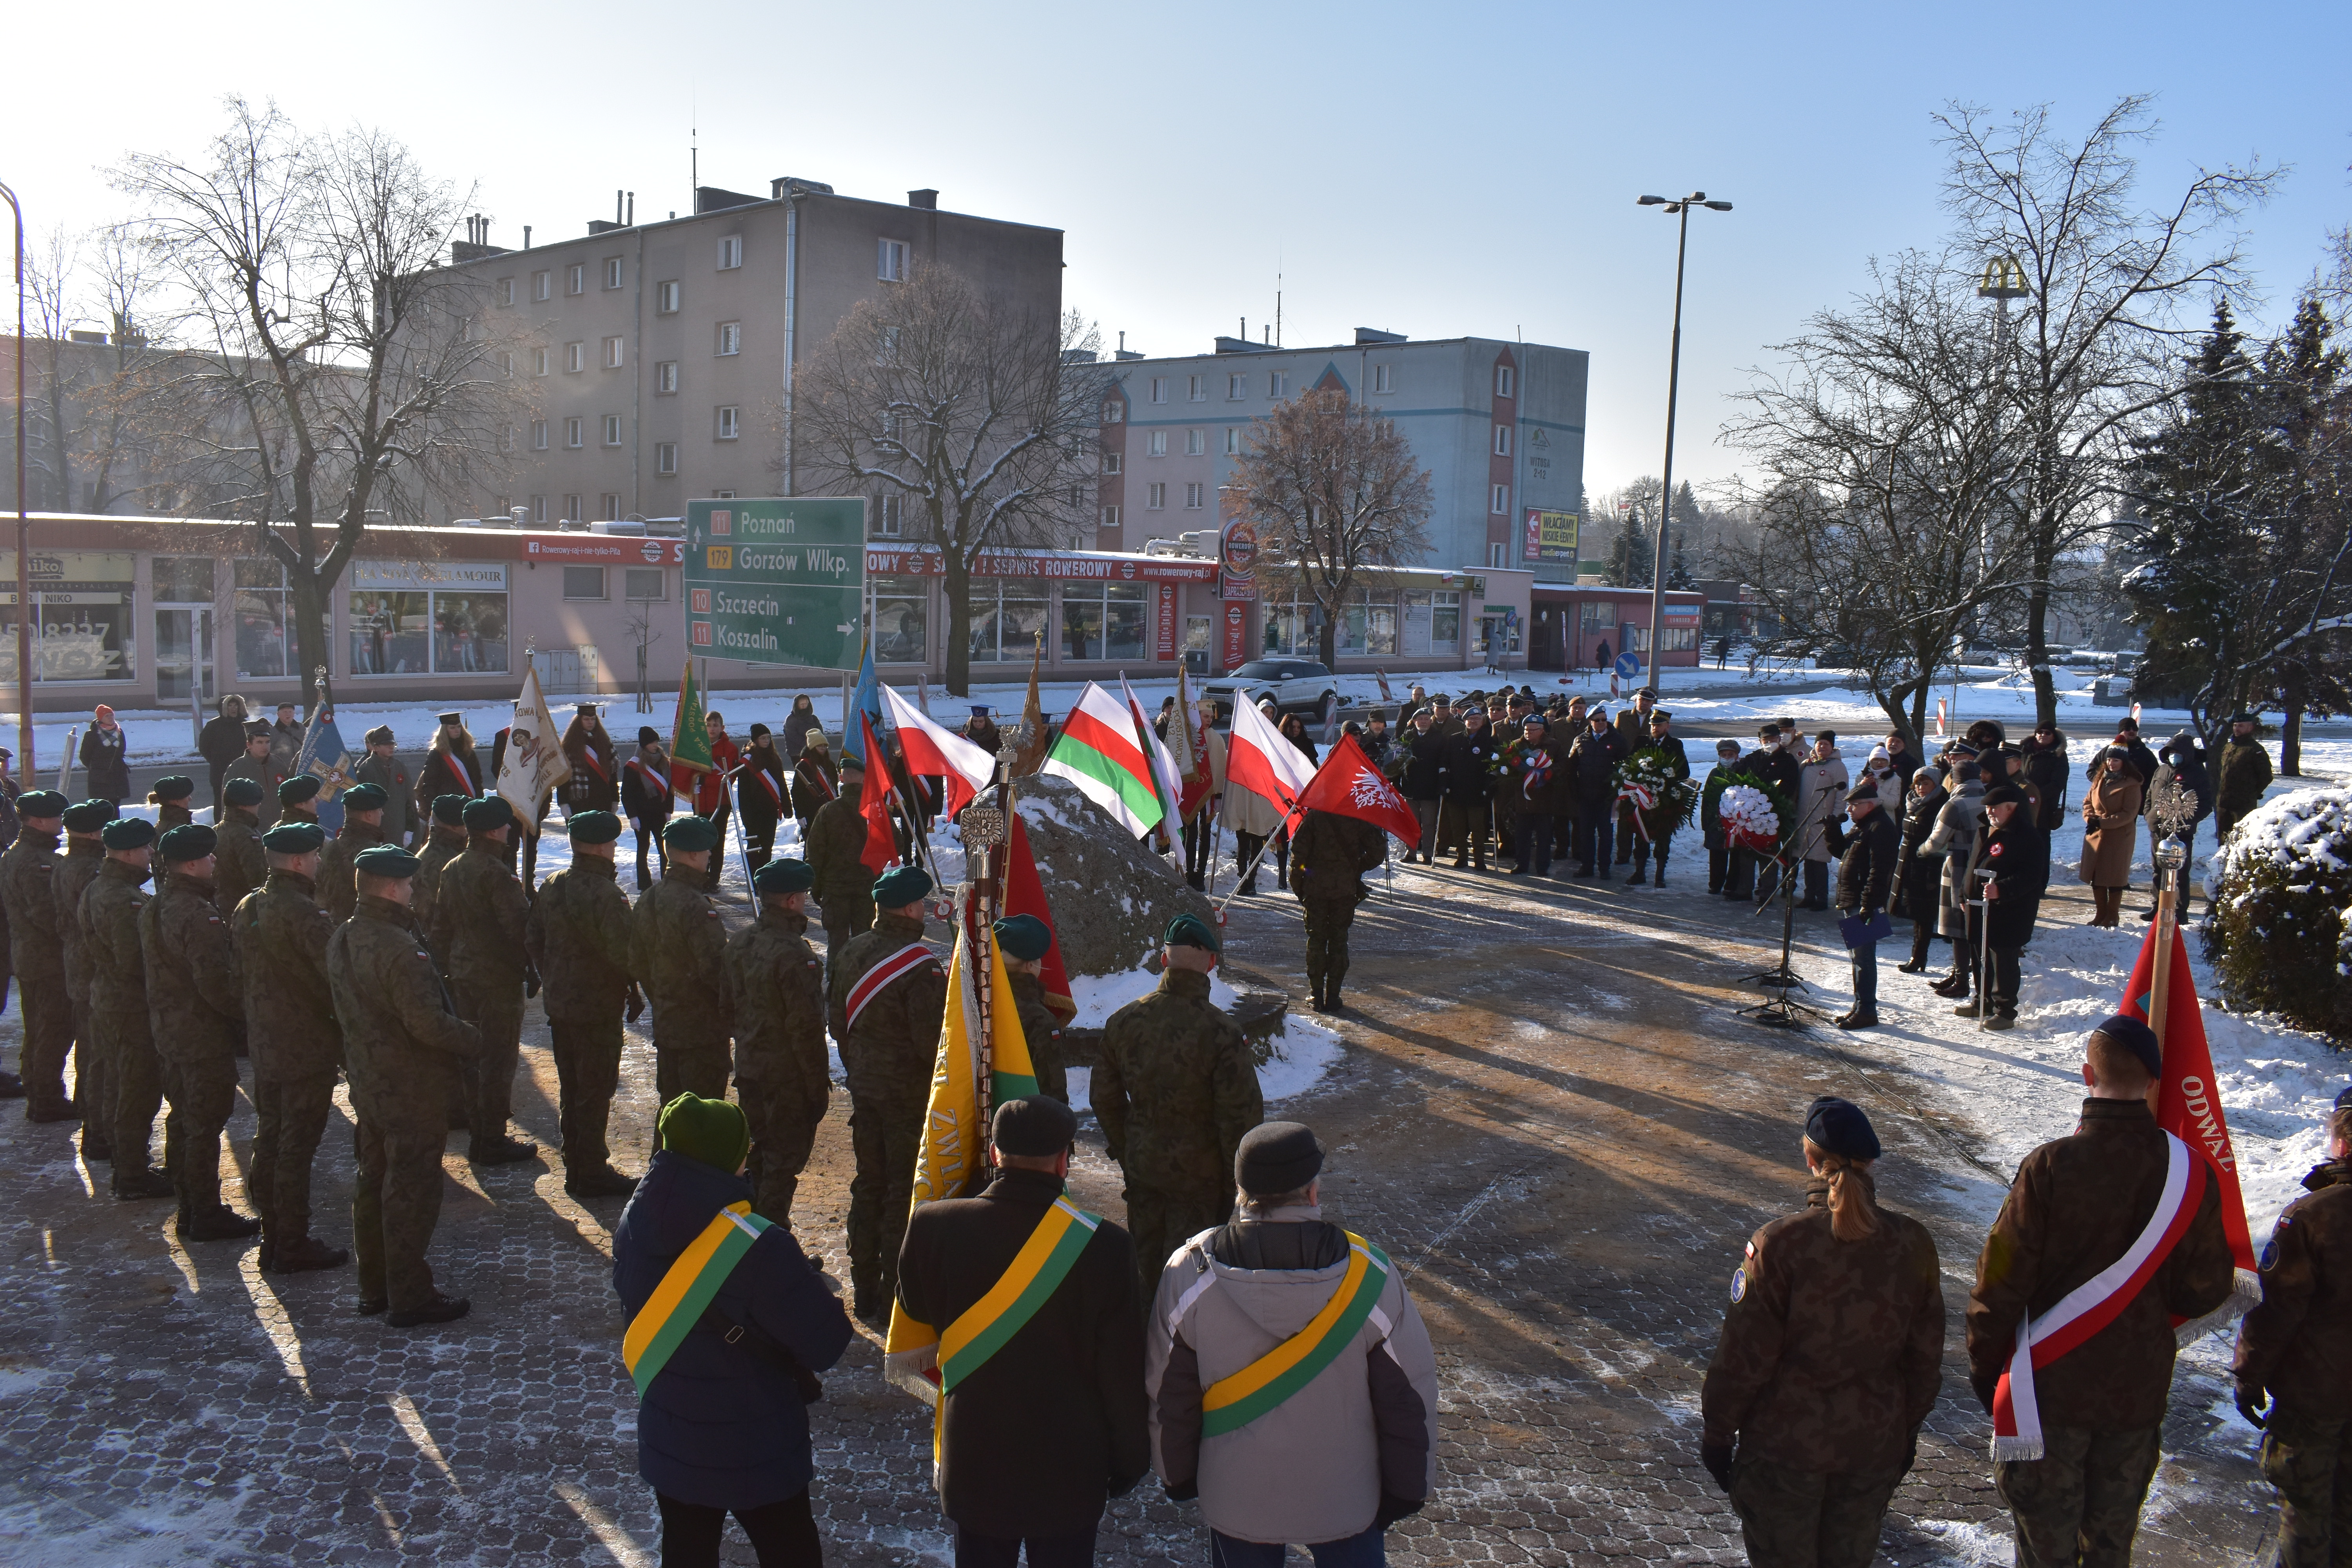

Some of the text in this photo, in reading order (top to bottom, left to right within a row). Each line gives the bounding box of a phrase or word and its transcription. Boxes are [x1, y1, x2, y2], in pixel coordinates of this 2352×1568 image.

[1530, 456, 1550, 468] WITOSA
[1534, 468, 1546, 479] 2-12
[716, 512, 795, 534] 11 Poznań
[1542, 530, 1559, 541] NISKIE
[542, 545, 621, 556] Rowerowy-raj-i-nie-tylko-Piła
[711, 547, 849, 579] 179 Gorzów Wlkp.
[993, 559, 1039, 575] SERWIS
[1045, 560, 1112, 577] ROWEROWY
[439, 570, 501, 582] GLAMOUR
[1143, 568, 1211, 579] www.rowerowy-raj.pl
[10, 594, 72, 603] BR NIKO
[696, 592, 779, 616] 10 Szczecin
[697, 625, 778, 650] 11 Koszalin
[689, 697, 700, 733] PODSTAW
